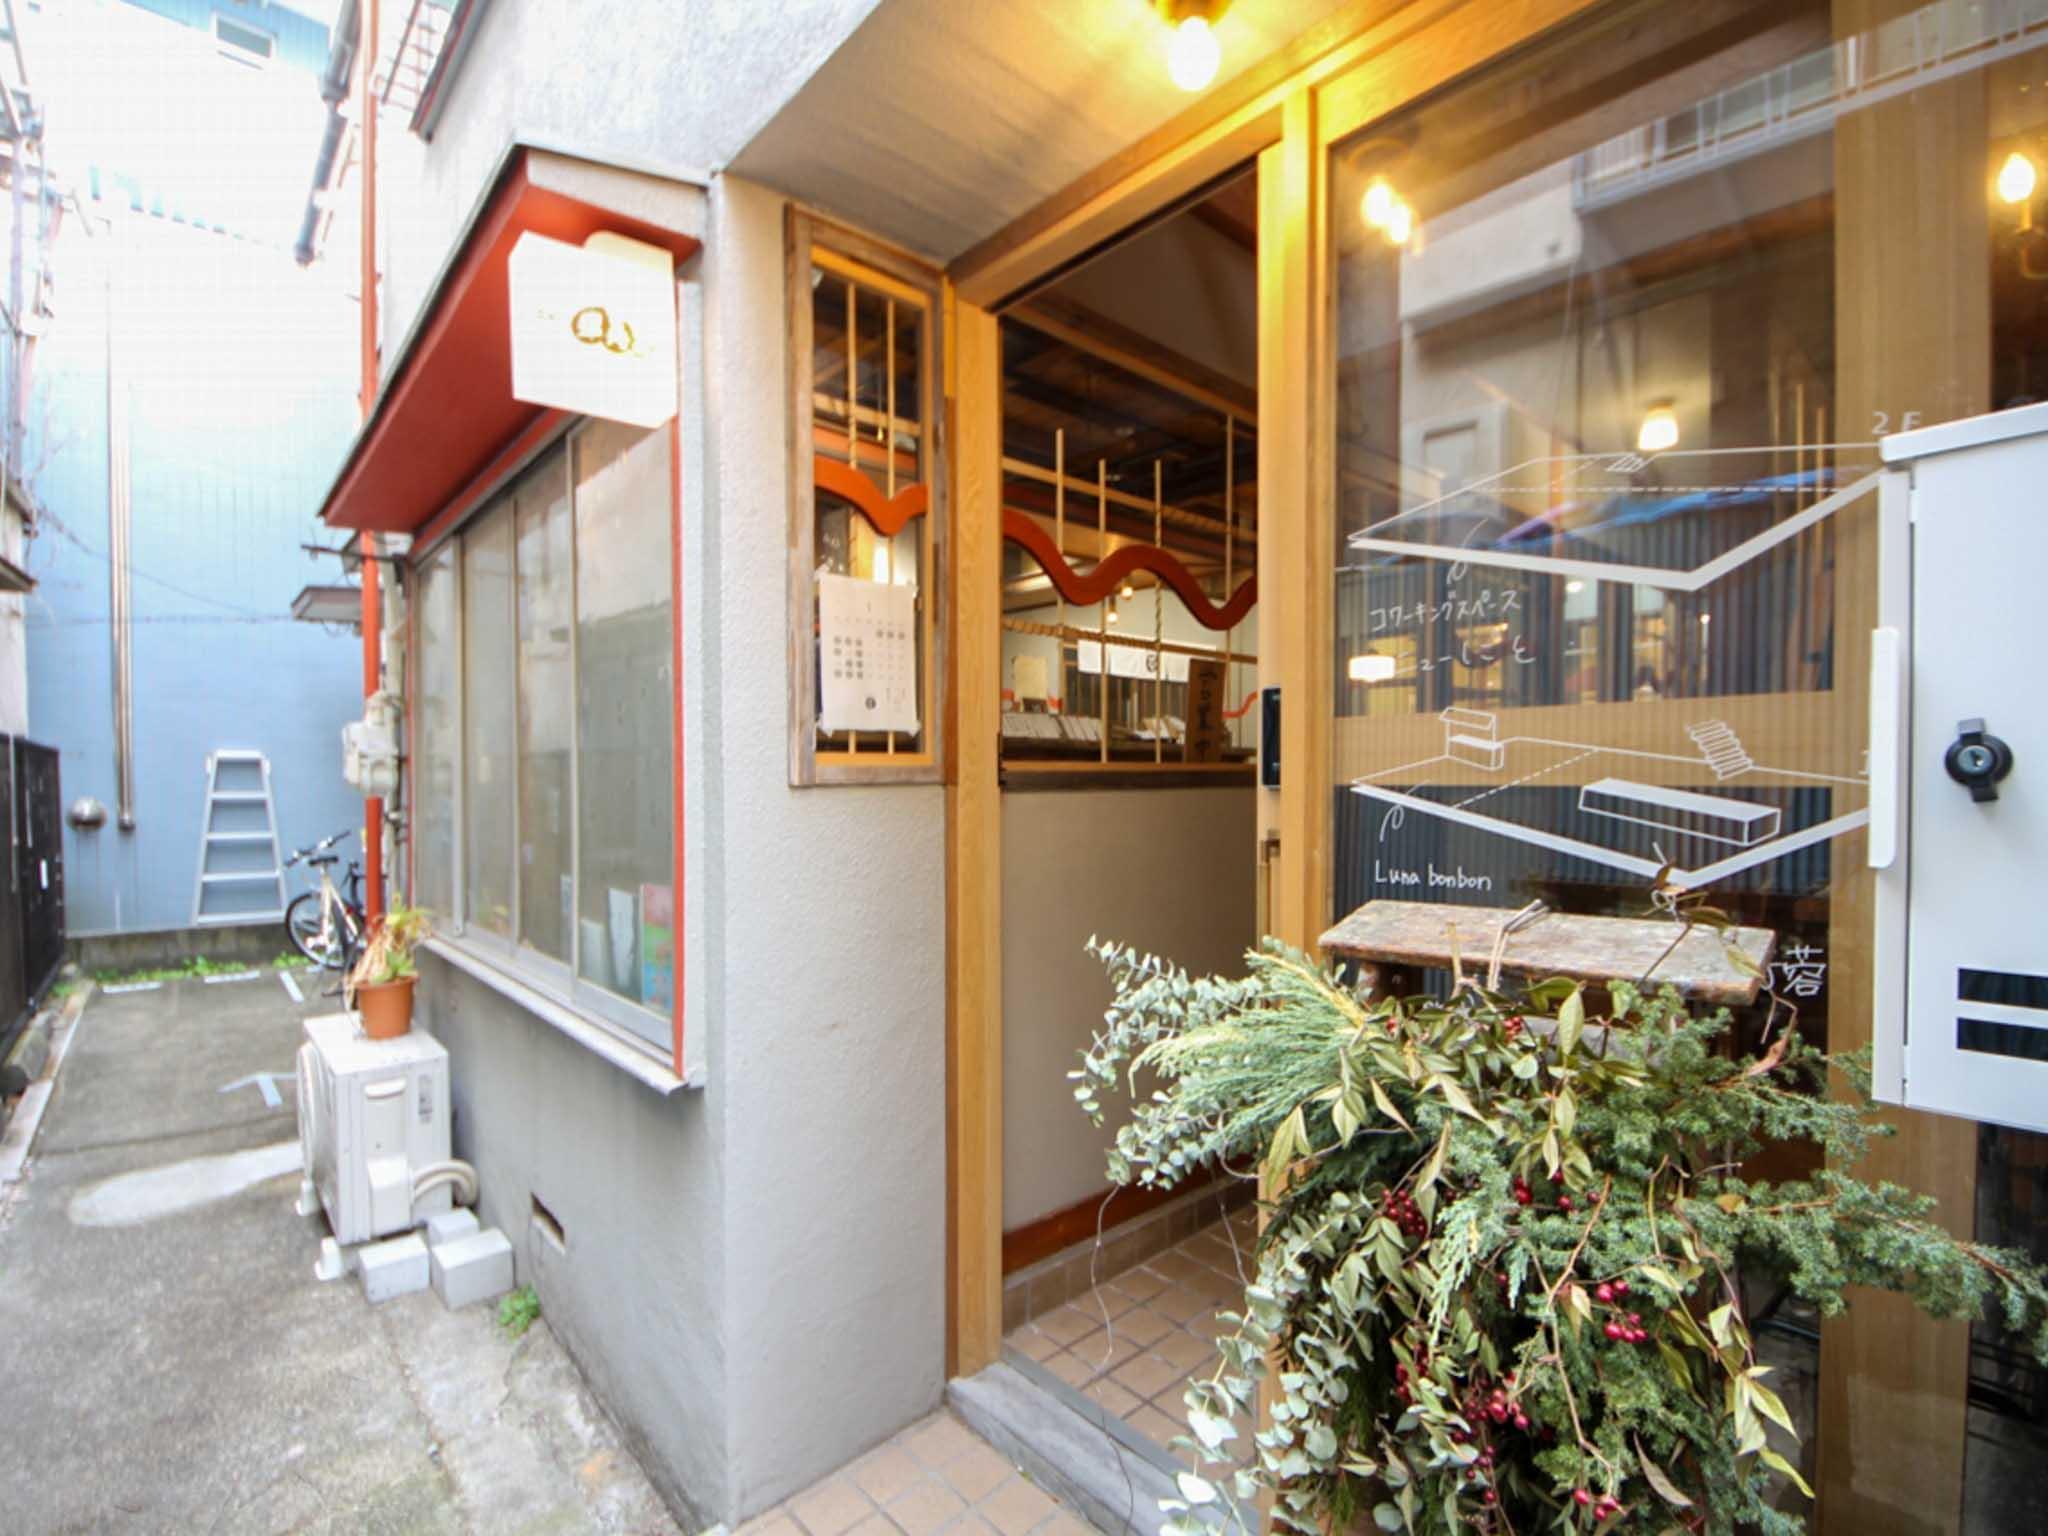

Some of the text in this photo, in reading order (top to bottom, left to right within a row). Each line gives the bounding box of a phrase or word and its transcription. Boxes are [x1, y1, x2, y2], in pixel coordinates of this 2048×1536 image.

[1369, 589, 1521, 632] コワーキングスペース
[1374, 859, 1492, 891] Luna bonbon
